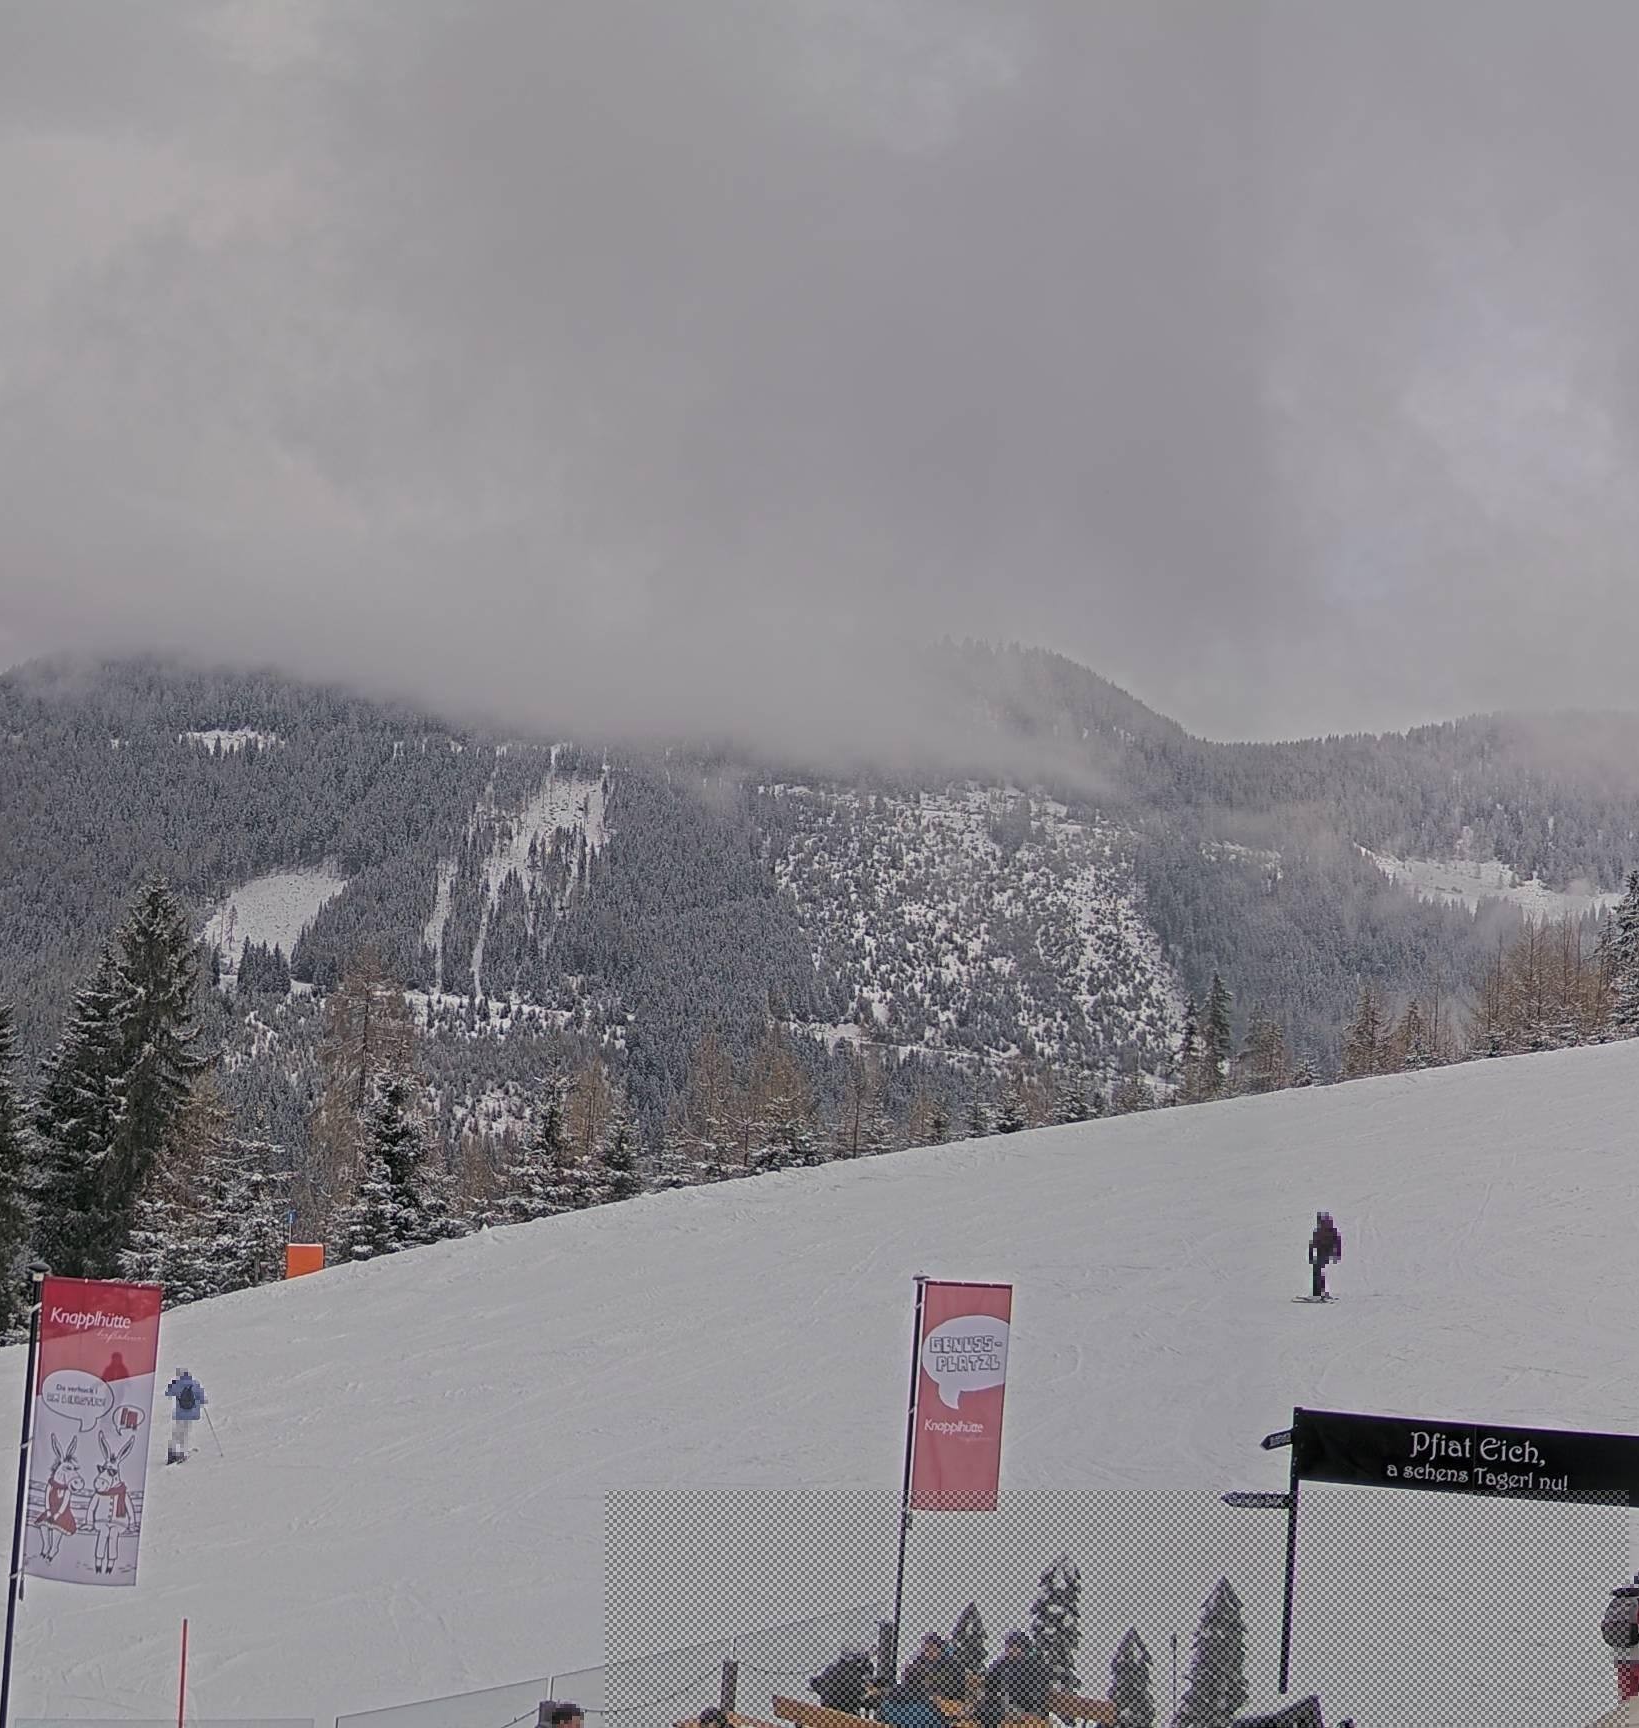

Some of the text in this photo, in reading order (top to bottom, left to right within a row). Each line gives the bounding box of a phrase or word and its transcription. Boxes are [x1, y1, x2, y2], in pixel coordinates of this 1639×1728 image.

[50, 1306, 132, 1329] Knapplhütte
[929, 1335, 1003, 1354] GENUSS-
[935, 1354, 1001, 1372] PLATZL
[1410, 1431, 1546, 1467] Pfiat Eich,
[1387, 1463, 1568, 1491] a schens Tagerl nu!
